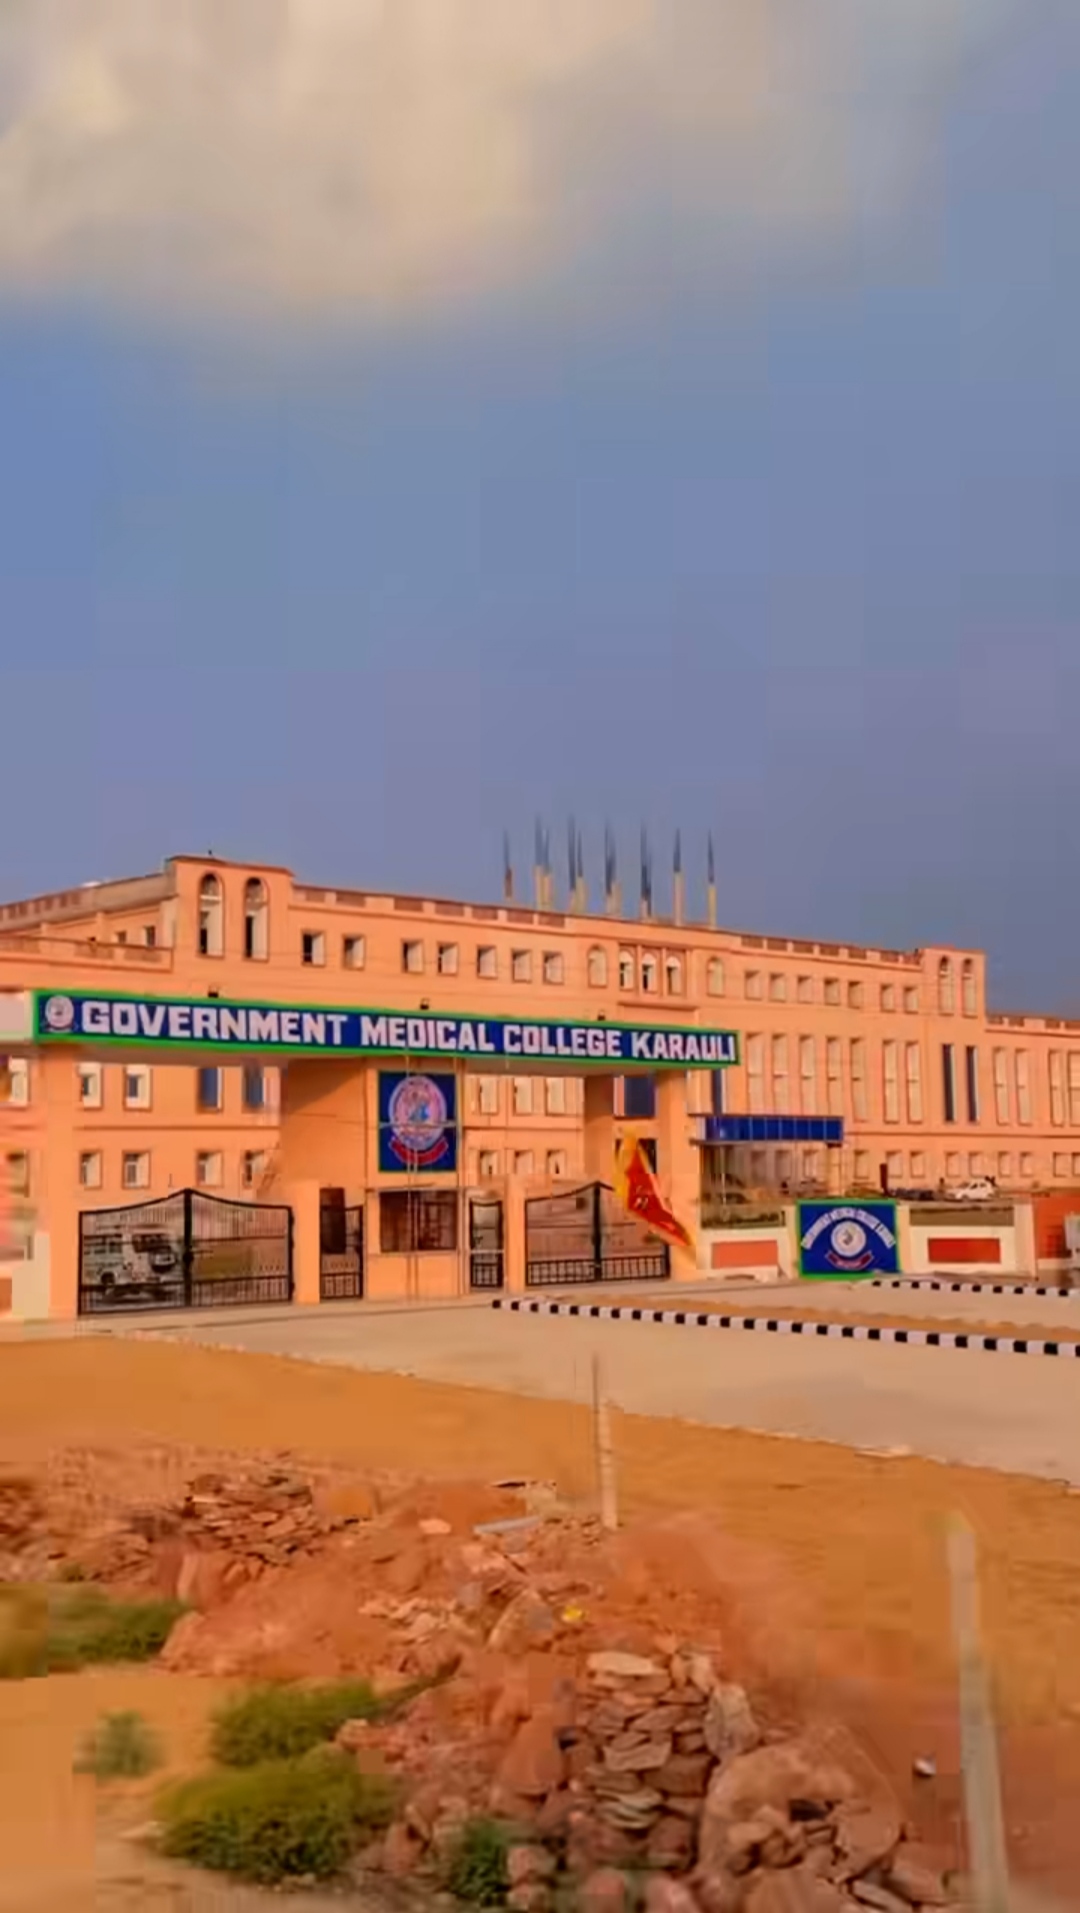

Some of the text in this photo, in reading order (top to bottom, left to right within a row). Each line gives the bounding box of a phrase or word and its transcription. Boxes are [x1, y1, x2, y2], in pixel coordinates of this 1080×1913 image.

[82, 1001, 736, 1061] GOVERNMENT MEDICAL COLLEGE KARAULI
